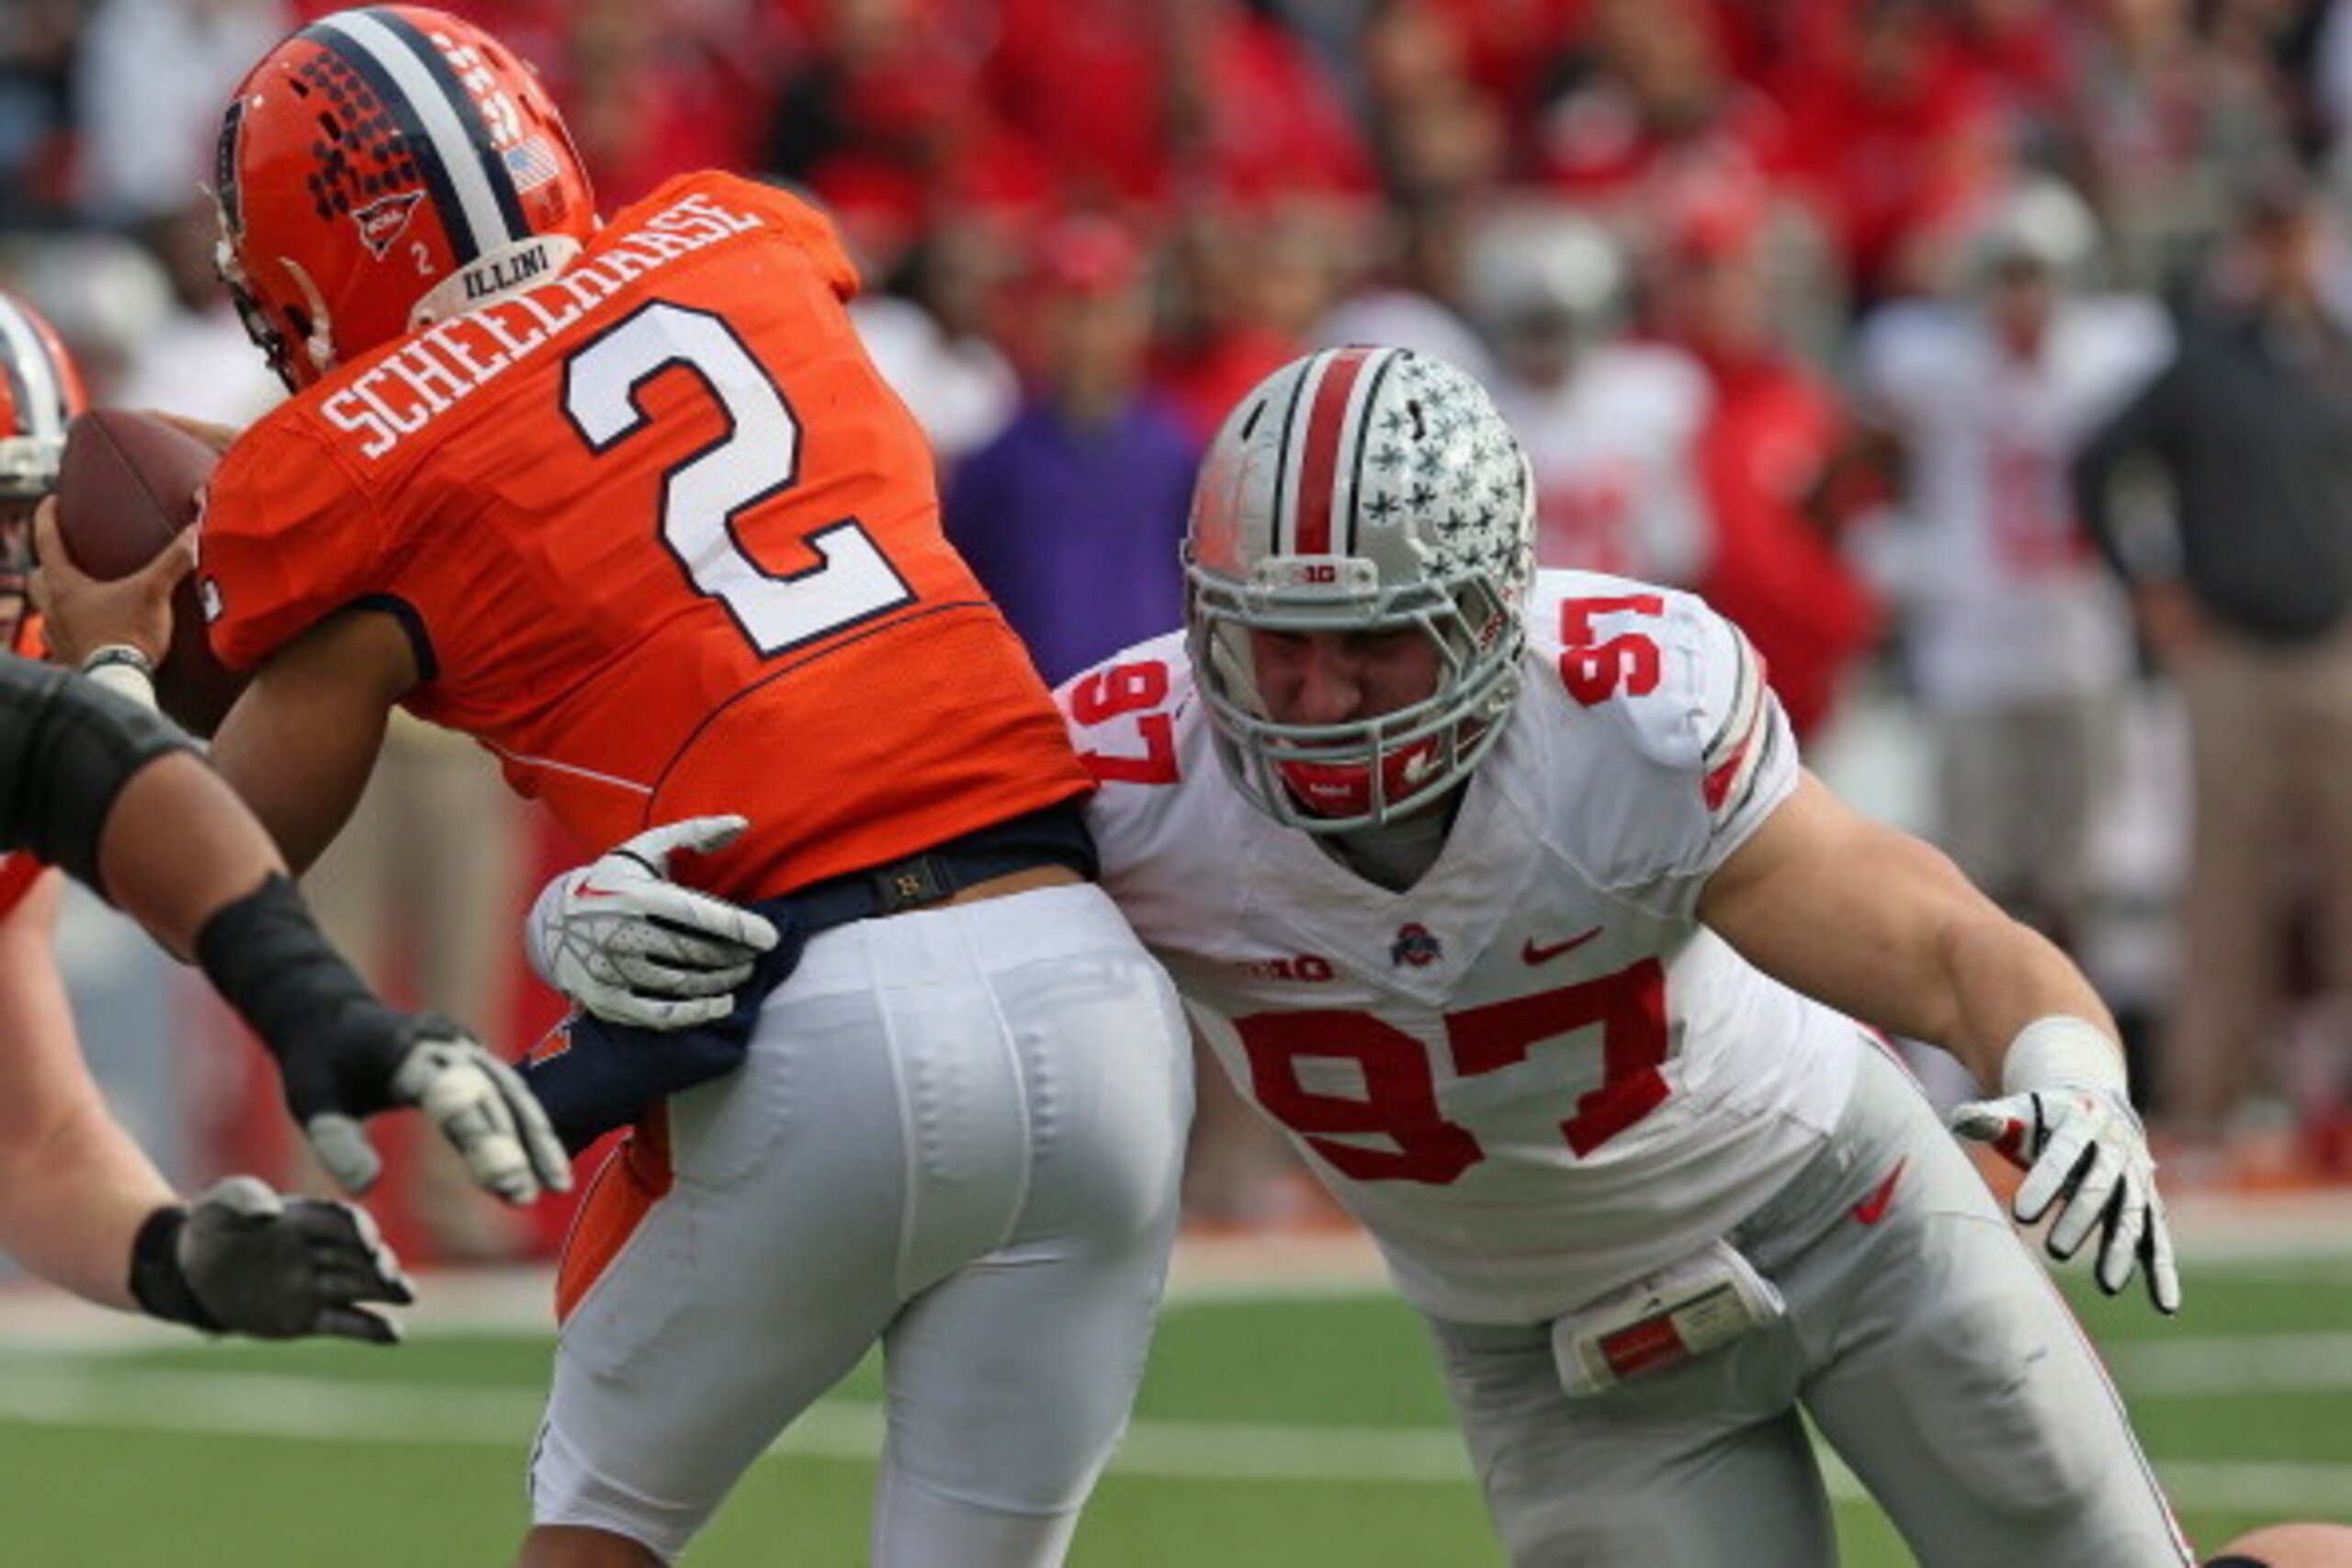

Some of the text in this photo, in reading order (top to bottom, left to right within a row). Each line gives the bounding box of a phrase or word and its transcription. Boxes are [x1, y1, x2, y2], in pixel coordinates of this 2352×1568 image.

[410, 241, 435, 275] 2
[463, 244, 548, 299] ILLINI
[560, 298, 920, 662] 2
[1560, 593, 1664, 707] 97
[1071, 660, 1181, 788] 97
[1233, 956, 1671, 1185] 97
